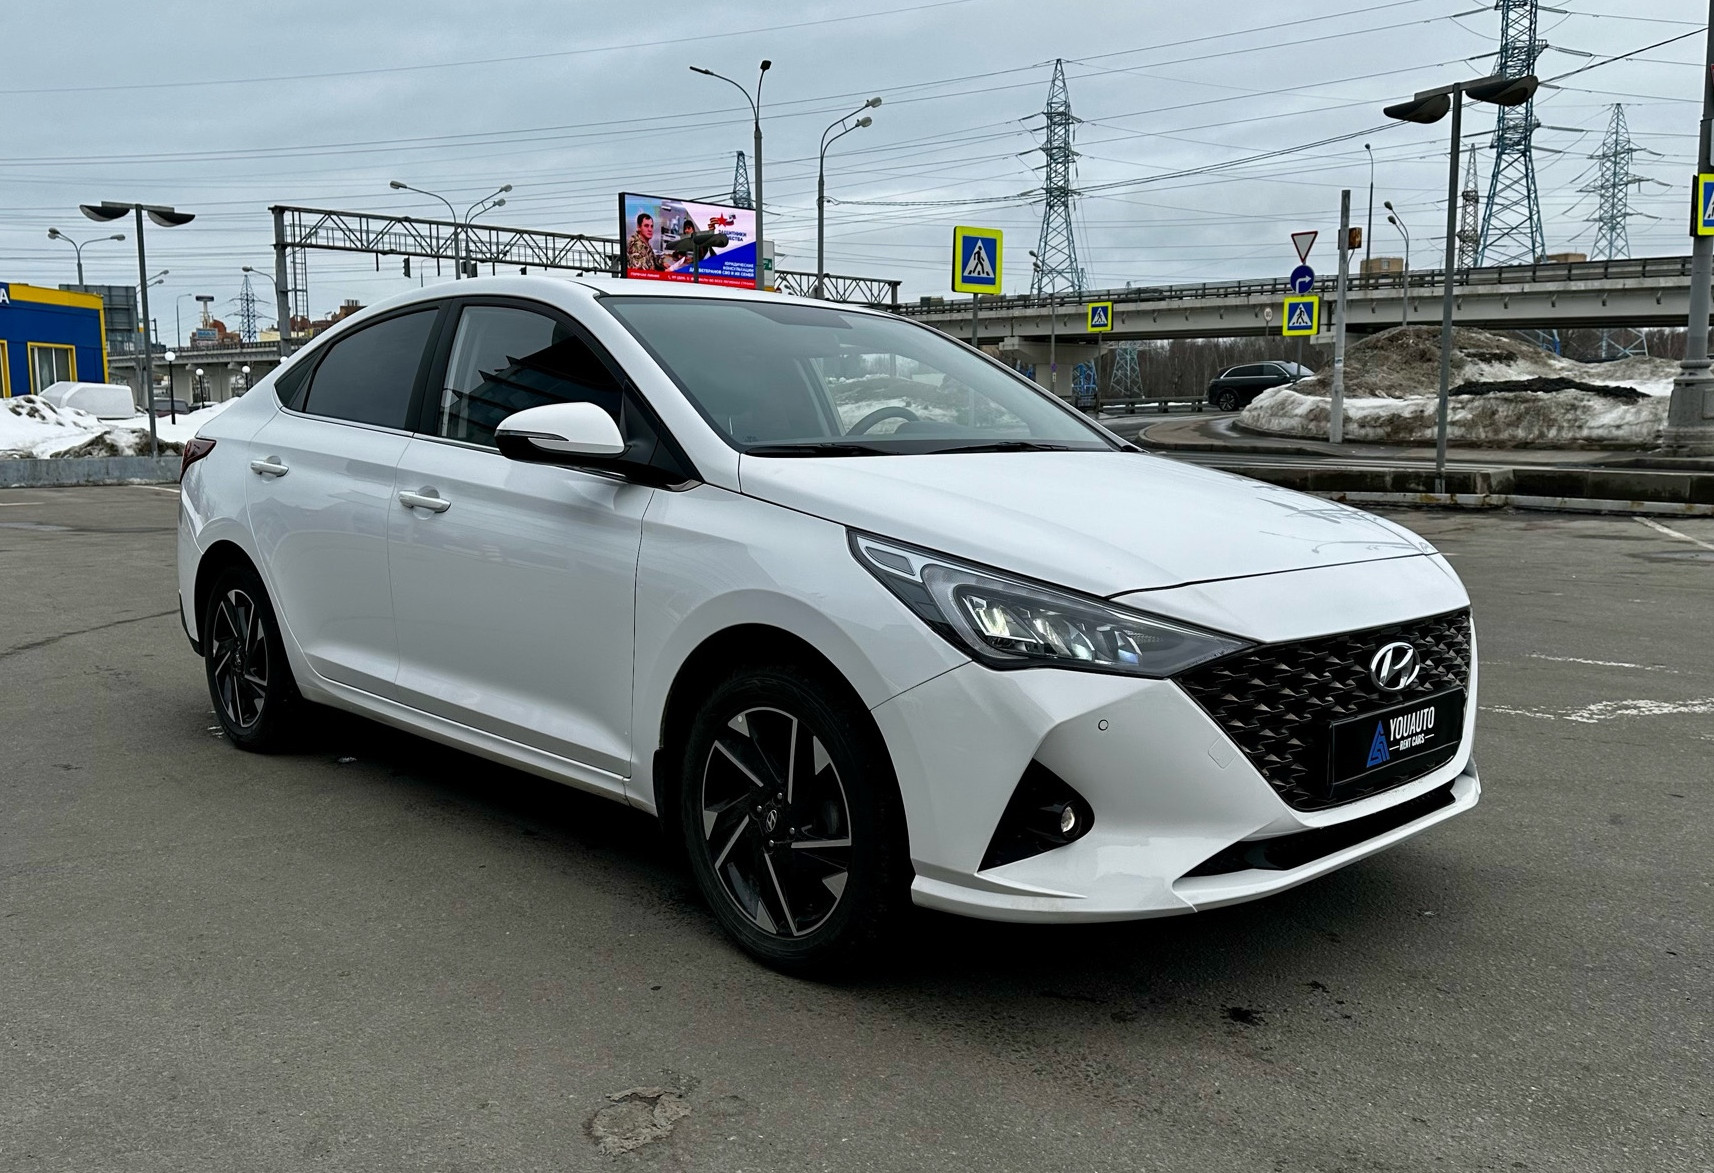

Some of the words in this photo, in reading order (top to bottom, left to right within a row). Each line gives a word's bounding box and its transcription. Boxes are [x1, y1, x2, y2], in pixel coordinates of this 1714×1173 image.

[1390, 706, 1435, 741] YOUAUTO
[1399, 738, 1412, 751] RENT
[1412, 733, 1425, 746] CARS
